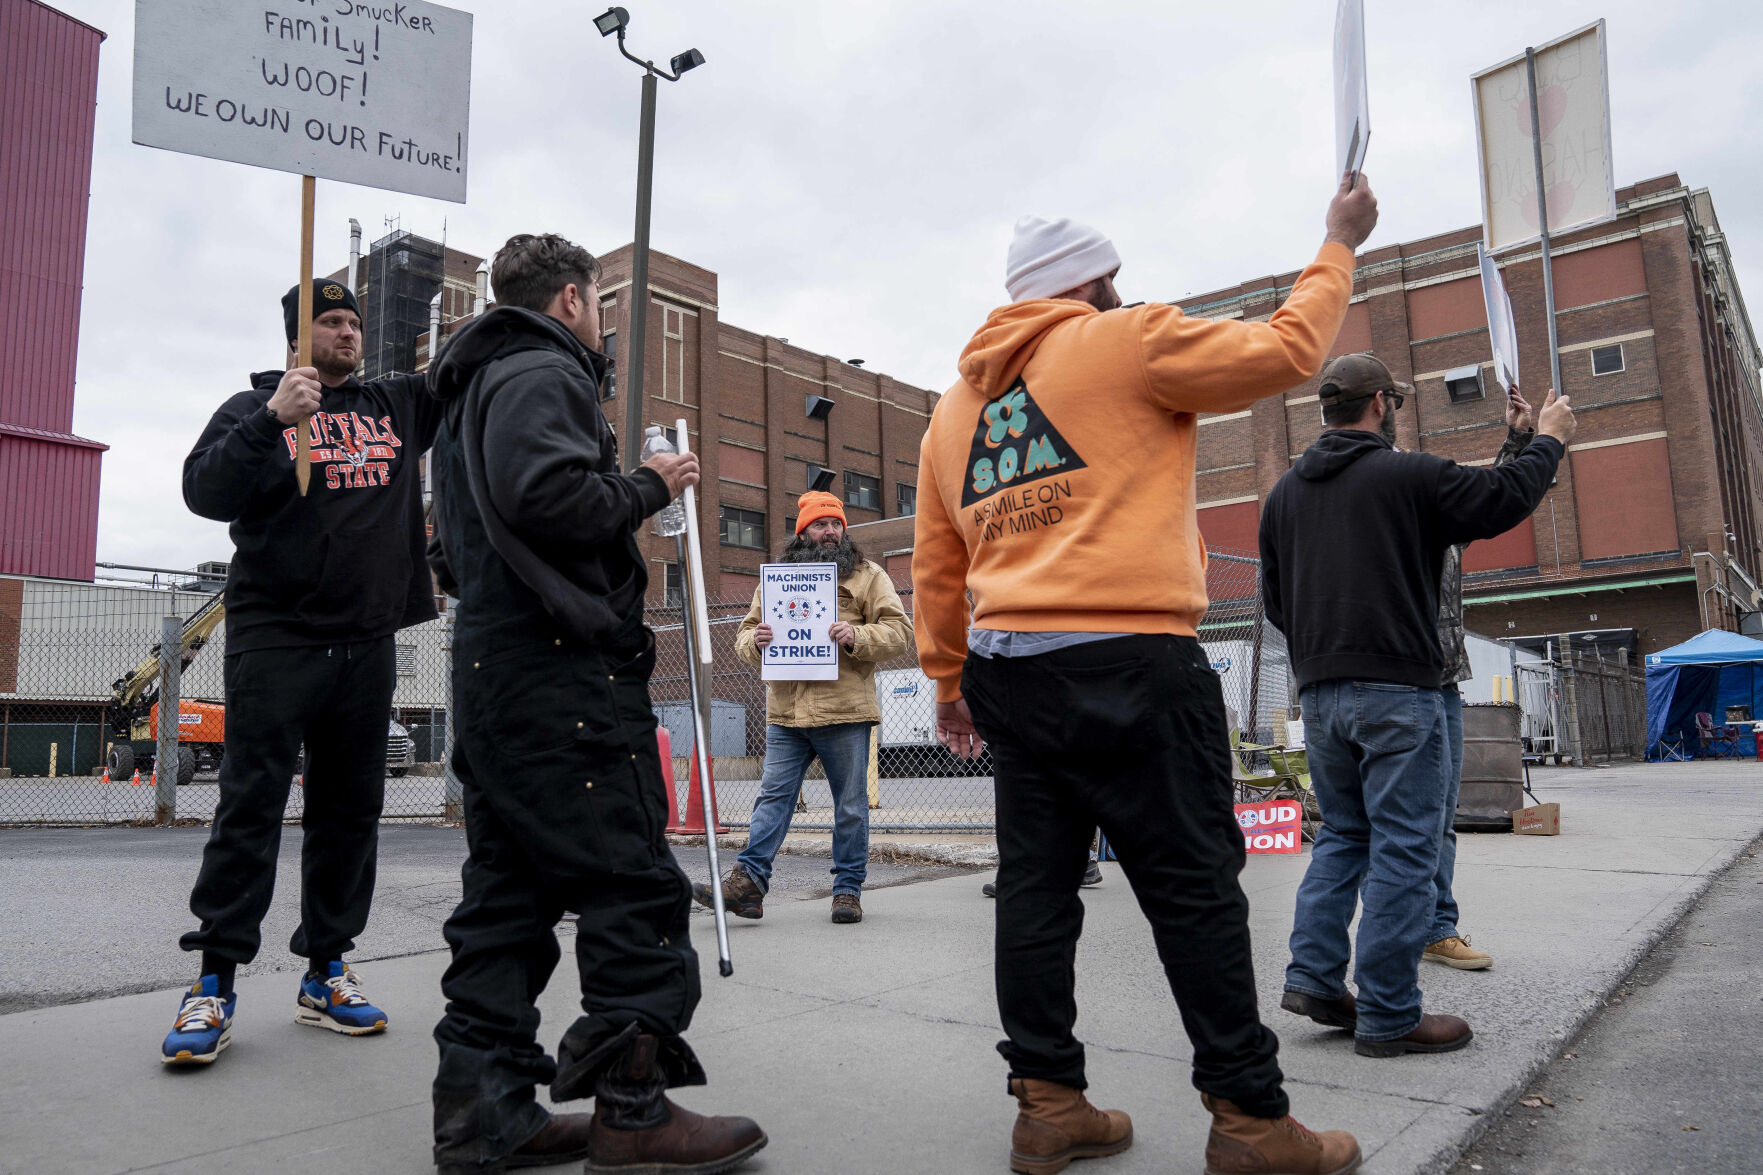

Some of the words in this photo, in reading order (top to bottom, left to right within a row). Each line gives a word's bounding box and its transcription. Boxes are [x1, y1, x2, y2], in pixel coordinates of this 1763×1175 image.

[261, 58, 368, 107] WOOF!
[165, 86, 208, 117] WE
[215, 99, 290, 133] OWN
[304, 118, 368, 152] OUR
[325, 462, 390, 489] STATE
[972, 433, 1067, 494] S.O.M.
[974, 509, 986, 527] A
[983, 489, 1035, 520] SMILE
[1037, 480, 1072, 503] ON
[981, 519, 1004, 544] MY
[1008, 505, 1064, 535] MIND
[767, 573, 832, 583] MACHINISTS
[781, 583, 817, 593] UNION
[787, 628, 812, 641] ON
[769, 645, 831, 658] STRIKE!
[1234, 806, 1297, 828] OUD
